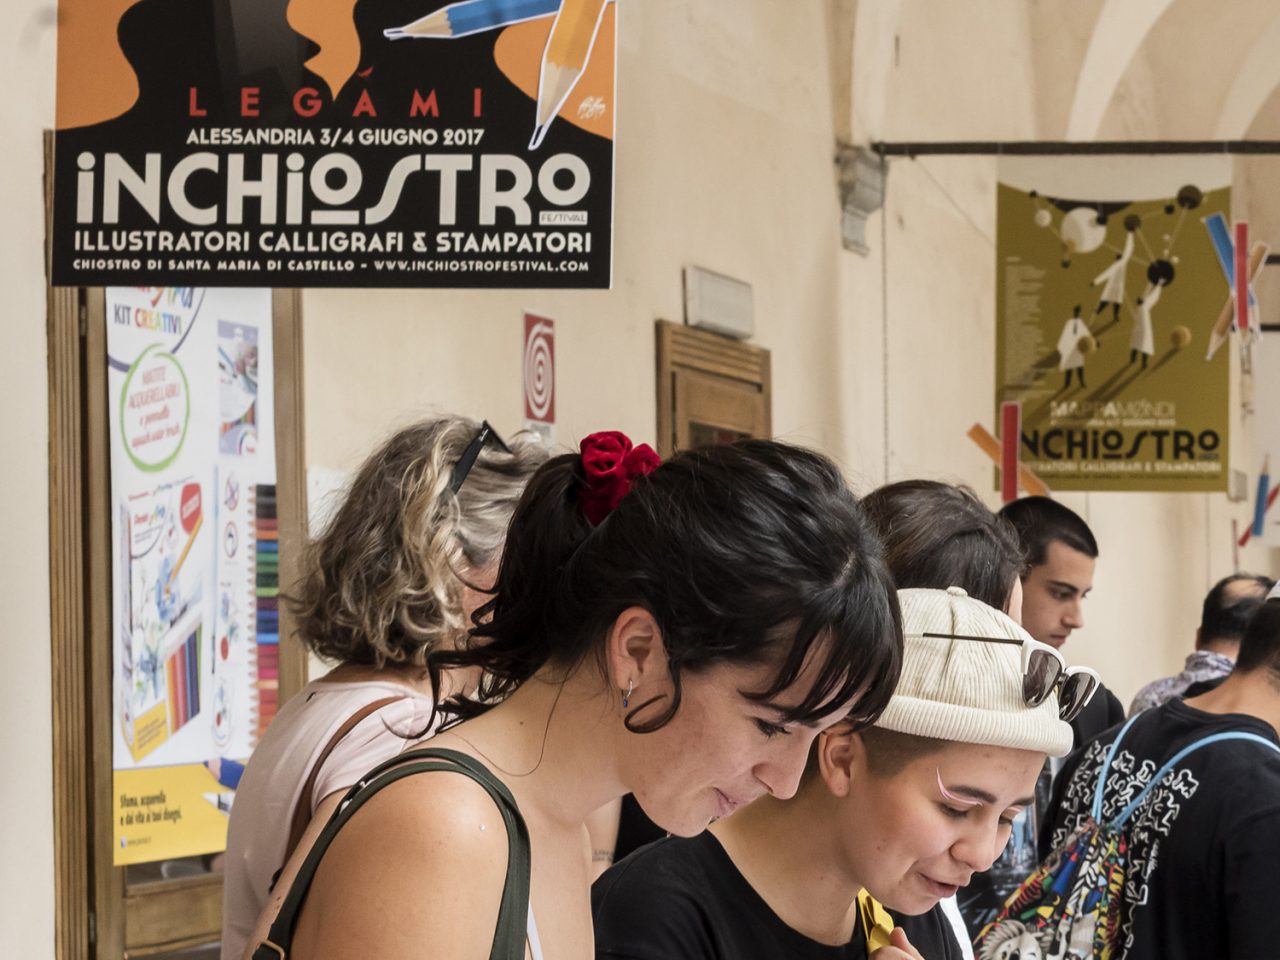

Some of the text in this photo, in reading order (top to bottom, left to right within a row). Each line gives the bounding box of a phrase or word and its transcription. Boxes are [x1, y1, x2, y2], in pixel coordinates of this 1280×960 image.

[186, 128, 485, 147] ALESSANDRIA 3/4 GIUGNO 2017
[74, 231, 591, 253] ILLUSTRATORI CALLIGRAFI & STAMPATORI
[73, 258, 141, 270] CHIOSTRO
[147, 259, 162, 270] DI
[168, 259, 211, 270] SANTA
[217, 259, 261, 270] MARIA
[267, 260, 282, 271] DI
[288, 259, 355, 271] CASTELLO
[374, 260, 589, 272] WWW.INCHIOSTROFESTIVAL.COM
[113, 303, 182, 336] KIT CREATIVI
